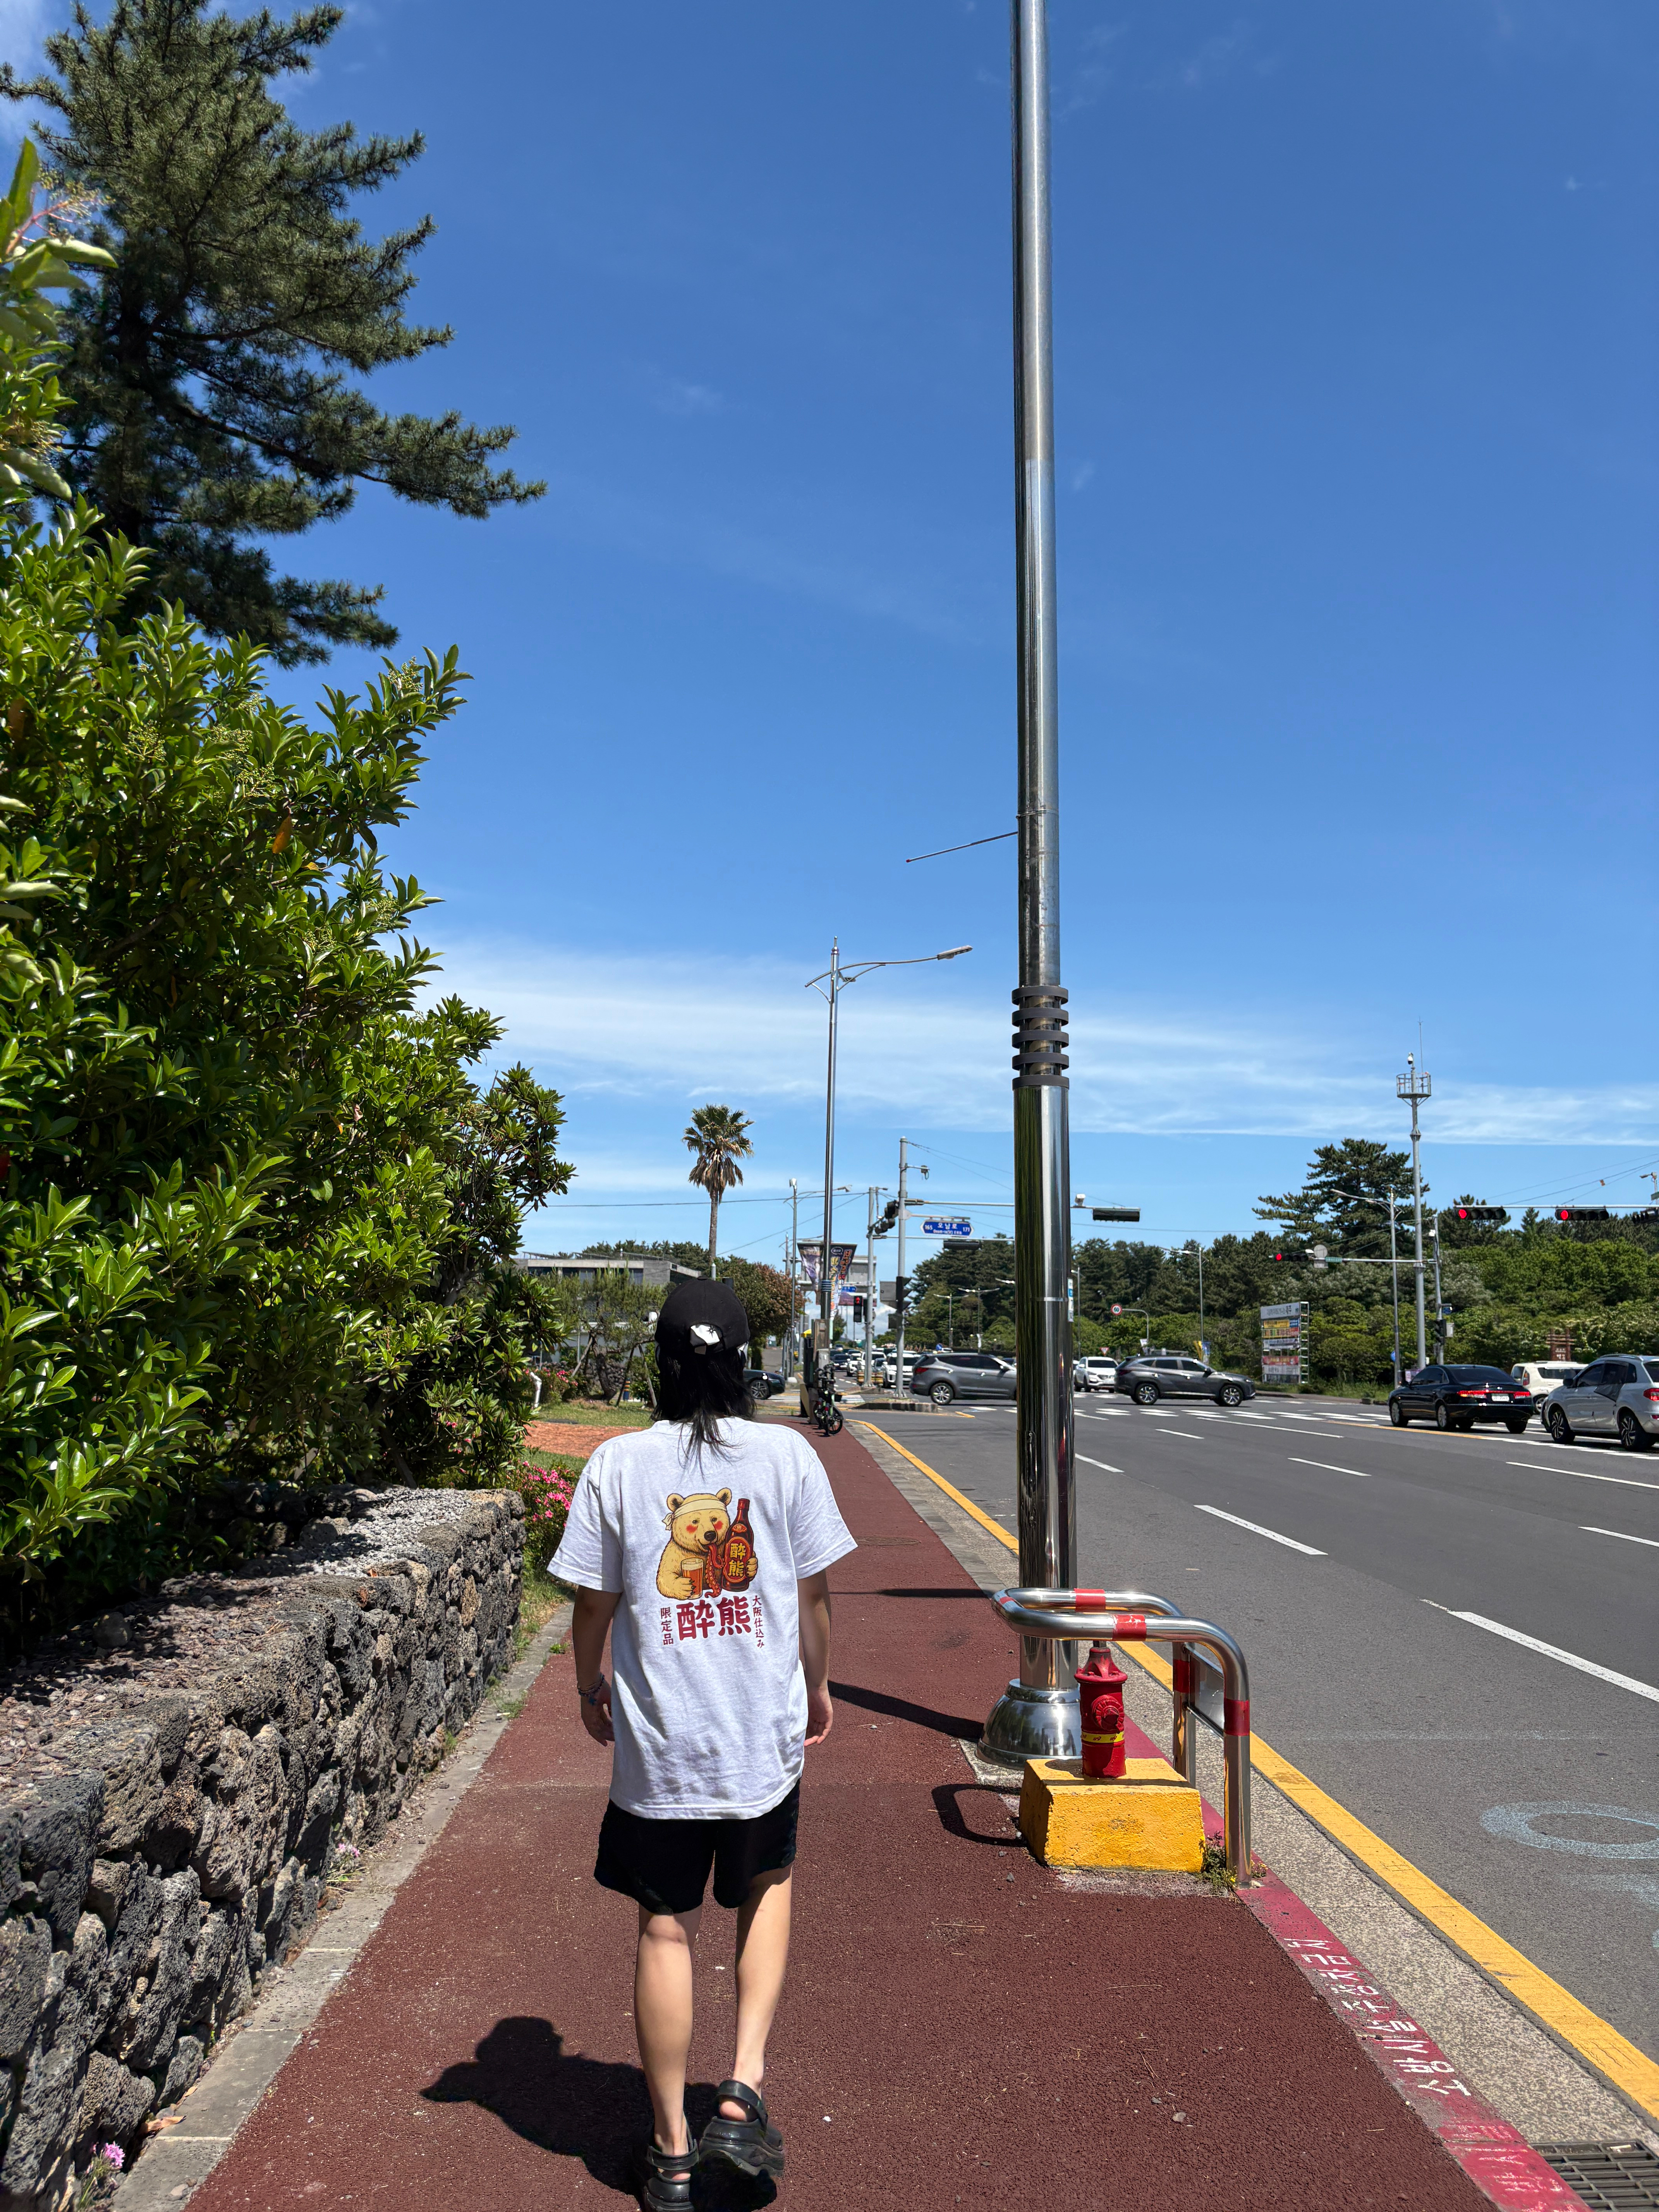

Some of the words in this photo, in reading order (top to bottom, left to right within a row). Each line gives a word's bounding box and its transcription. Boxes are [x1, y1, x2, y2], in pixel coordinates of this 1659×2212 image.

[660, 1606, 674, 1645] 限定品
[752, 1595, 765, 1648] 大阪仕込み
